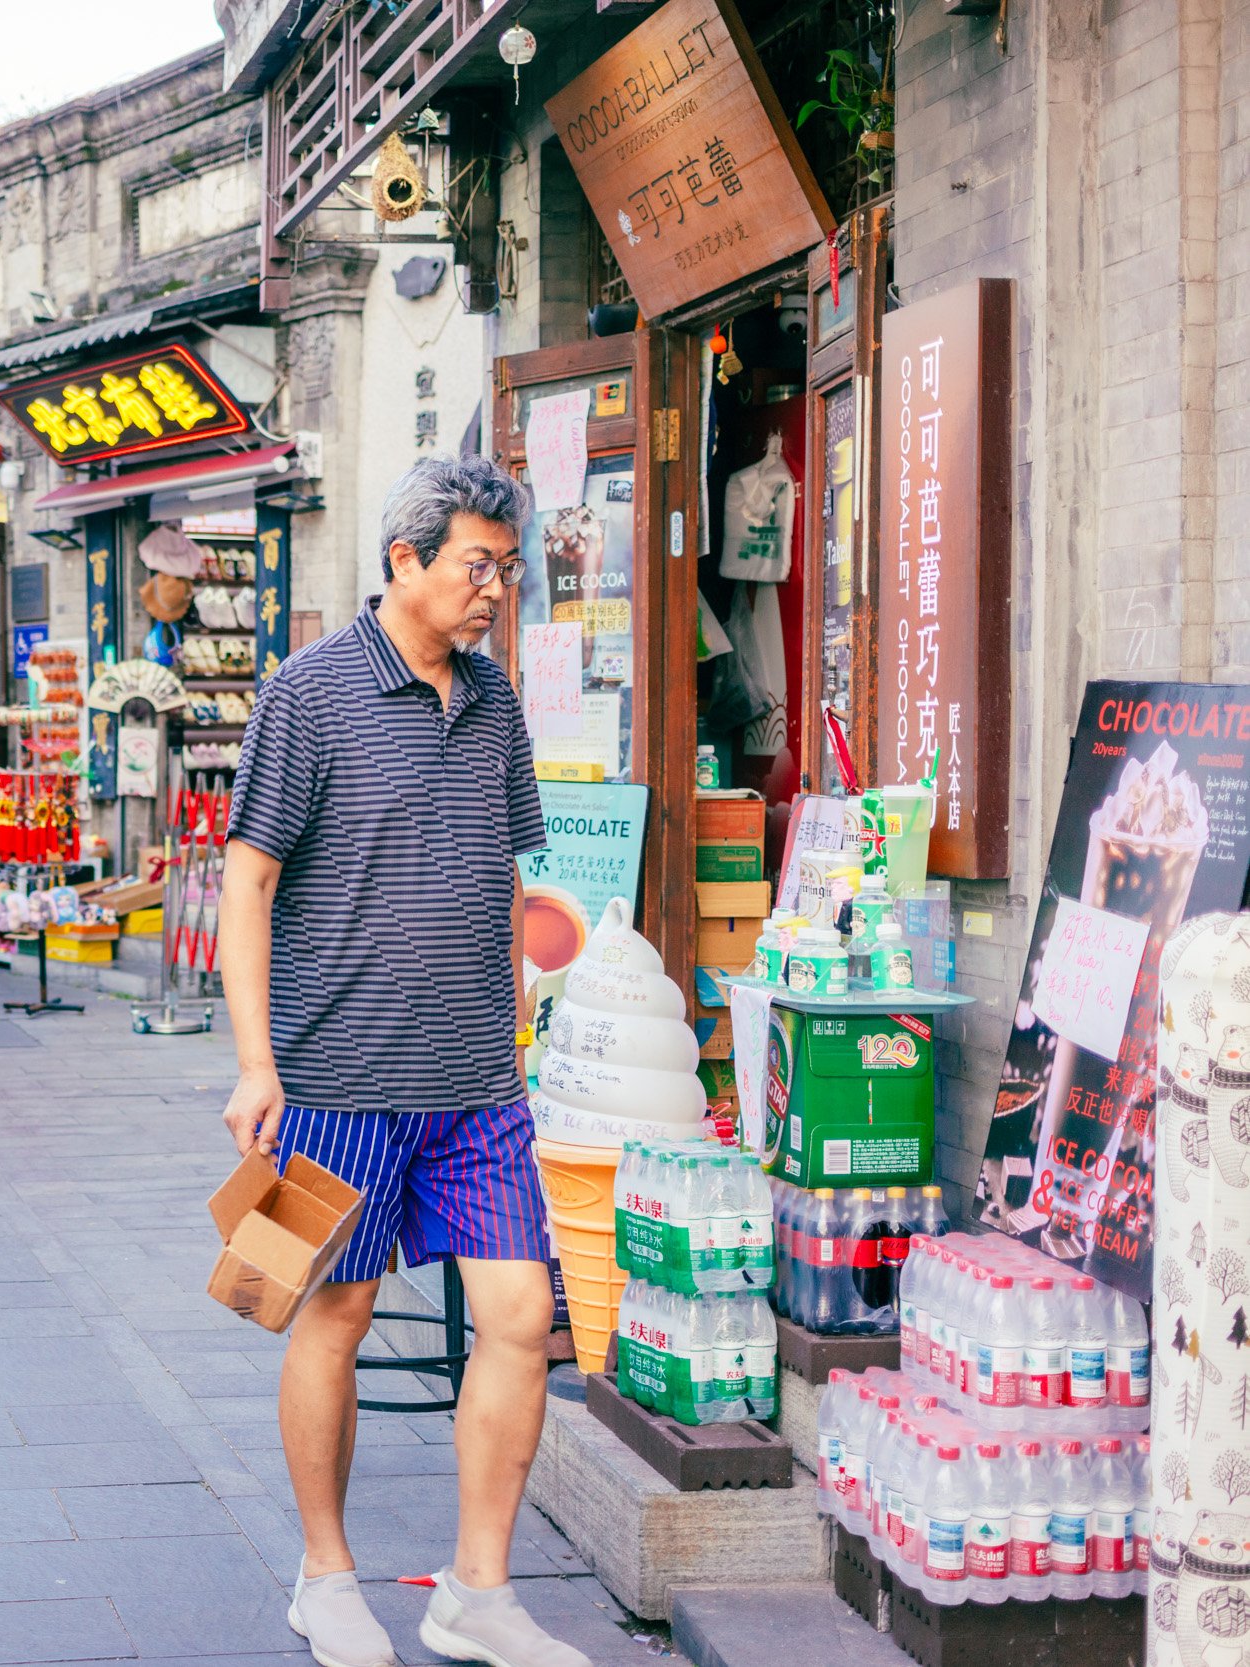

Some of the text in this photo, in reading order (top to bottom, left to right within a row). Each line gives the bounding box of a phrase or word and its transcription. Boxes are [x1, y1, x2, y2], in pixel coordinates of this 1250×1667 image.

[567, 19, 716, 154] COCOABALLET
[628, 136, 743, 239] 可可芭蕾
[27, 362, 217, 453] 北京布鞋
[415, 365, 438, 466] 宜興
[899, 356, 911, 600] COCOABALLET
[826, 534, 851, 566] TakeO
[557, 572, 627, 591] ICE COCOA
[897, 618, 908, 790] CHOCOLA
[1098, 700, 1250, 740] CHOCOLATE
[948, 702, 961, 830] 匠人本店
[543, 816, 631, 838] HOCOLATE
[766, 1075, 788, 1115] GTAO
[1033, 1169, 1053, 1214] &
[1046, 1135, 1153, 1202] ICE COCOA
[1060, 1177, 1146, 1232] ICE COFFEE
[1055, 1208, 1139, 1262] ICE CREAM
[967, 1547, 1004, 1561] 农夫山泉
